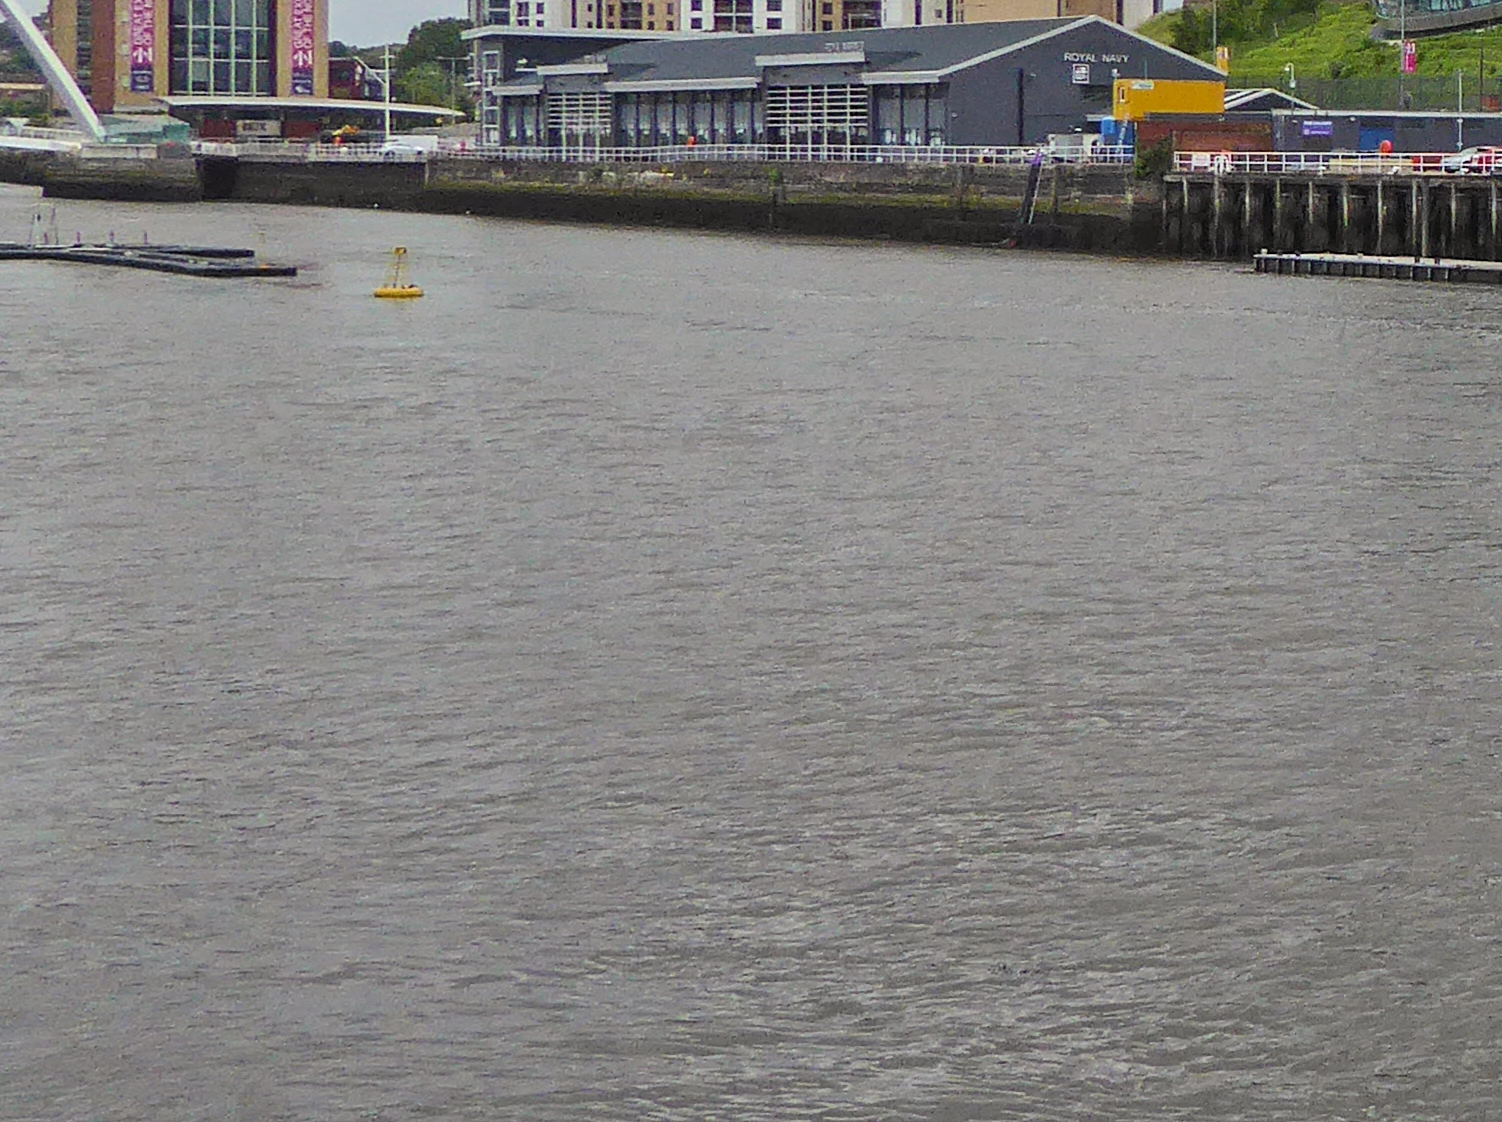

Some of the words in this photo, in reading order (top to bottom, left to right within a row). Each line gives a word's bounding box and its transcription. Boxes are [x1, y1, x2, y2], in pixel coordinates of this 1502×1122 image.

[144, 10, 153, 28] THE
[304, 14, 312, 32] THE
[133, 13, 143, 45] GREAT
[293, 17, 303, 49] GREAT
[144, 33, 152, 45] OF
[304, 36, 312, 49] OF
[1064, 52, 1097, 62] ROYAL
[1101, 54, 1129, 63] NAVY
